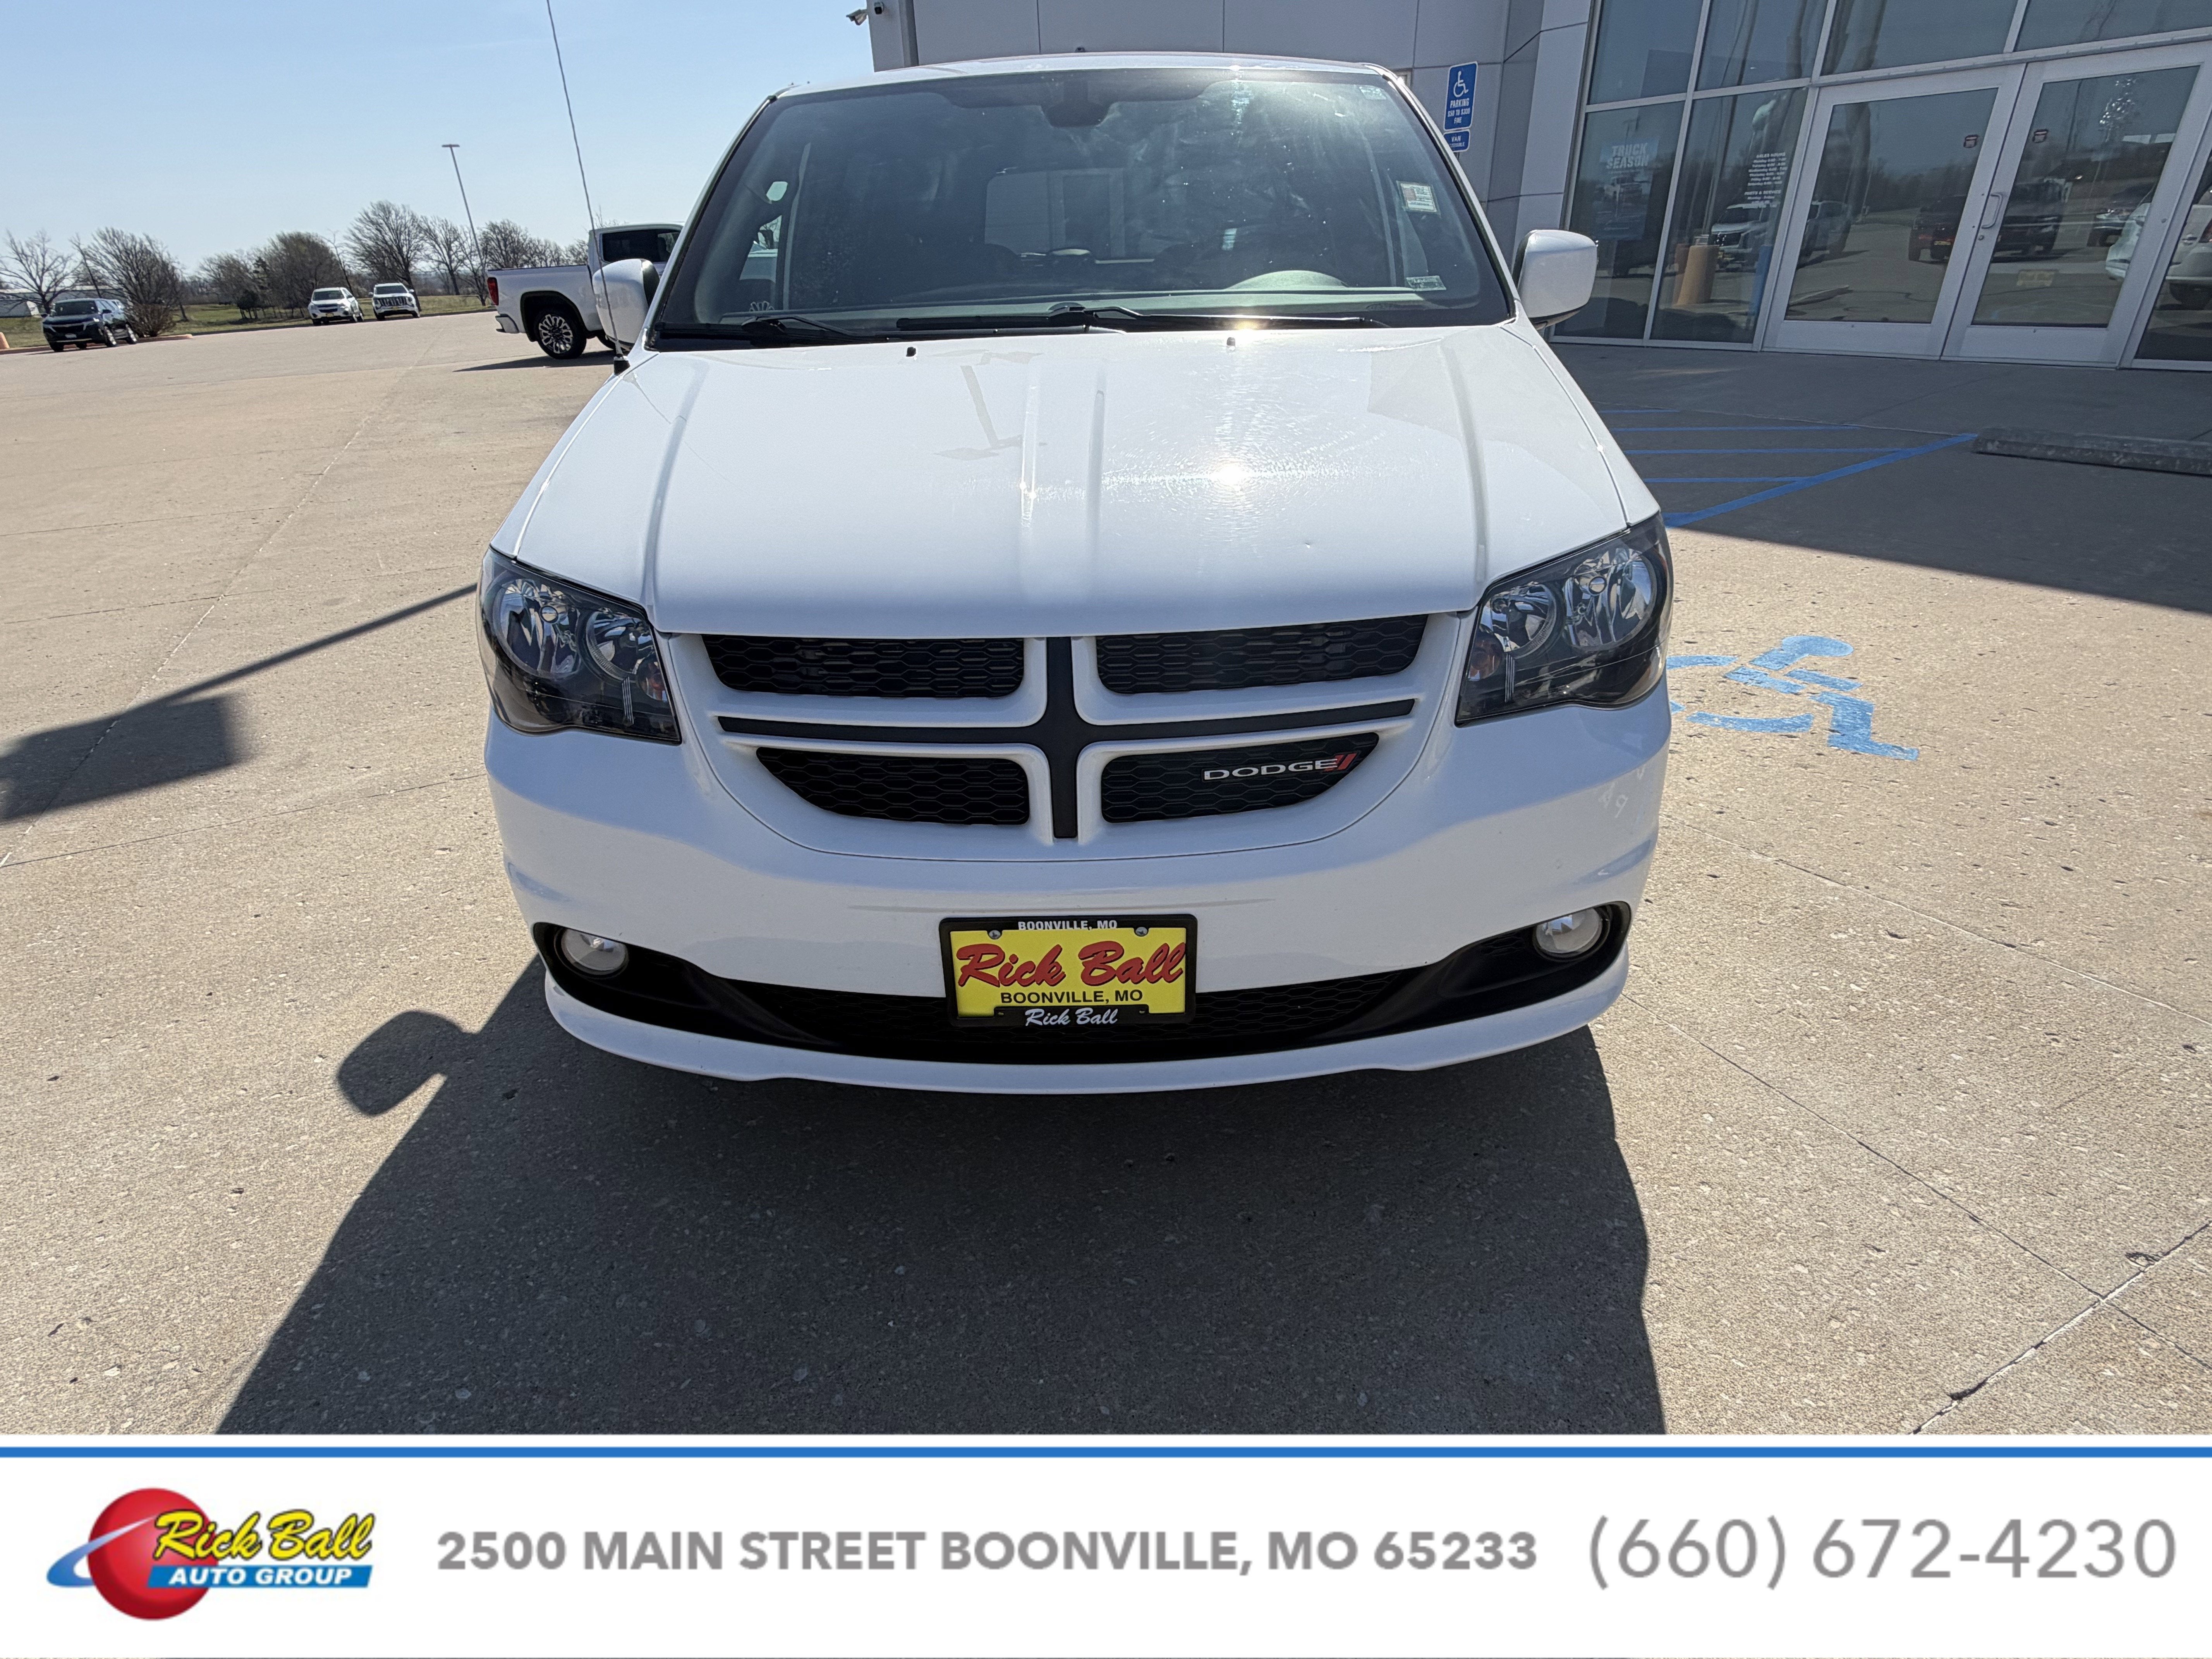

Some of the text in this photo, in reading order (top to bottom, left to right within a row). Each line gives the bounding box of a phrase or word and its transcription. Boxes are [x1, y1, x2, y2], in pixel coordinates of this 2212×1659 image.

[1450, 98, 1469, 108] PARKING
[1612, 143, 1648, 156] TRUCK
[1606, 155, 1650, 169] SEASON
[1204, 758, 1338, 780] DODGE
[1018, 920, 1118, 931] BOONVILLE, MO
[956, 940, 1186, 988] Rick Ball
[1001, 989, 1143, 1004] BOONVILLE, MO
[1025, 1007, 1118, 1026] Rick Ball
